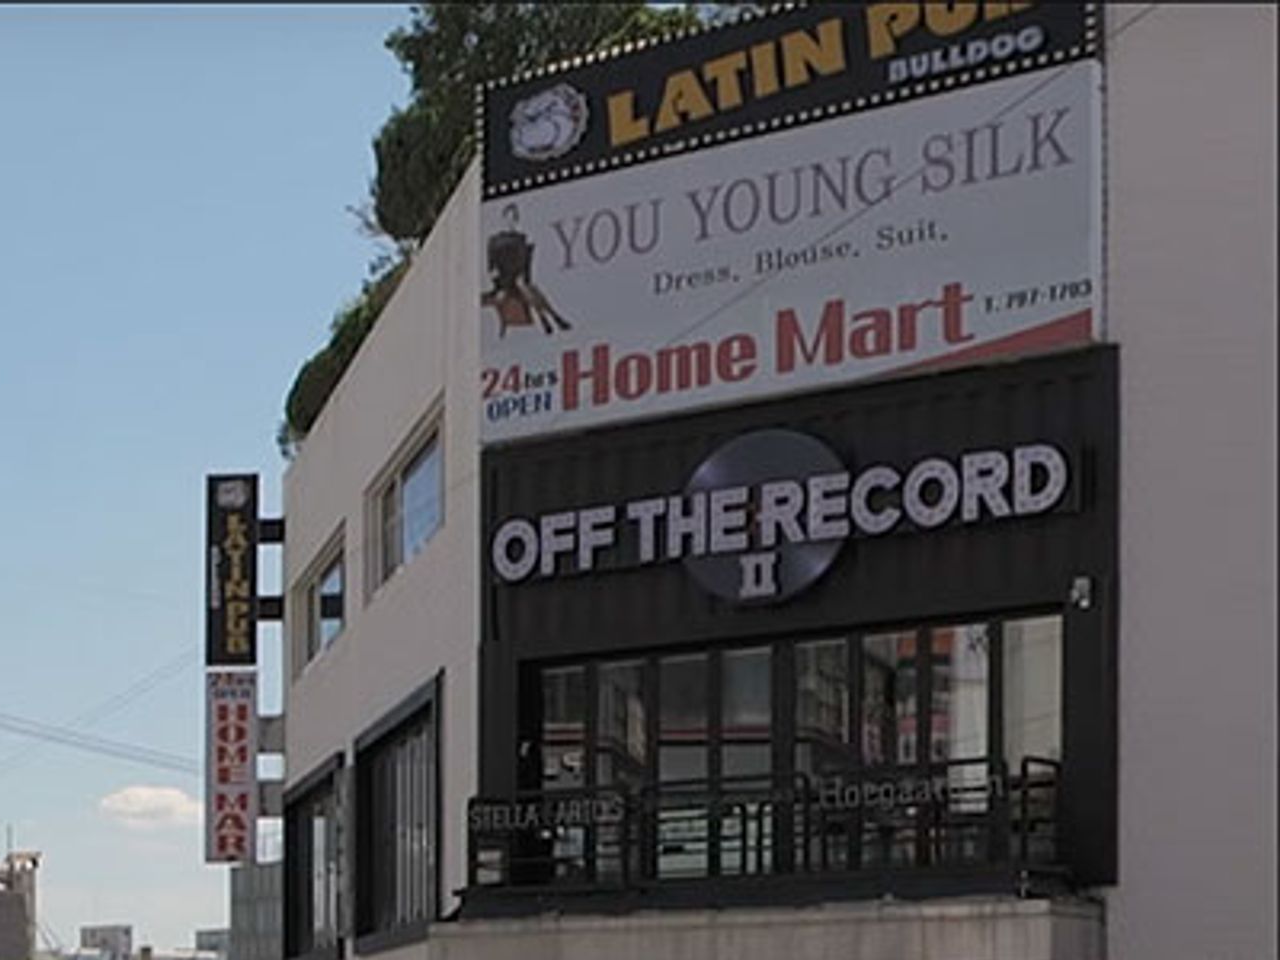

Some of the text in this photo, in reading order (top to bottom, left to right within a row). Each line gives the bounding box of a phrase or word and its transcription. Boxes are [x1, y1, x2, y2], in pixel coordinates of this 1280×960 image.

[607, 18, 846, 147] LATIN
[889, 25, 1044, 83] BULLDOG
[550, 105, 1074, 272] YOU YOUNG SILK
[486, 390, 552, 423] OPEN
[561, 331, 757, 410] Home
[774, 282, 975, 373] Mart
[491, 444, 1069, 583] OFF THE RECORD
[216, 703, 249, 784] HOME
